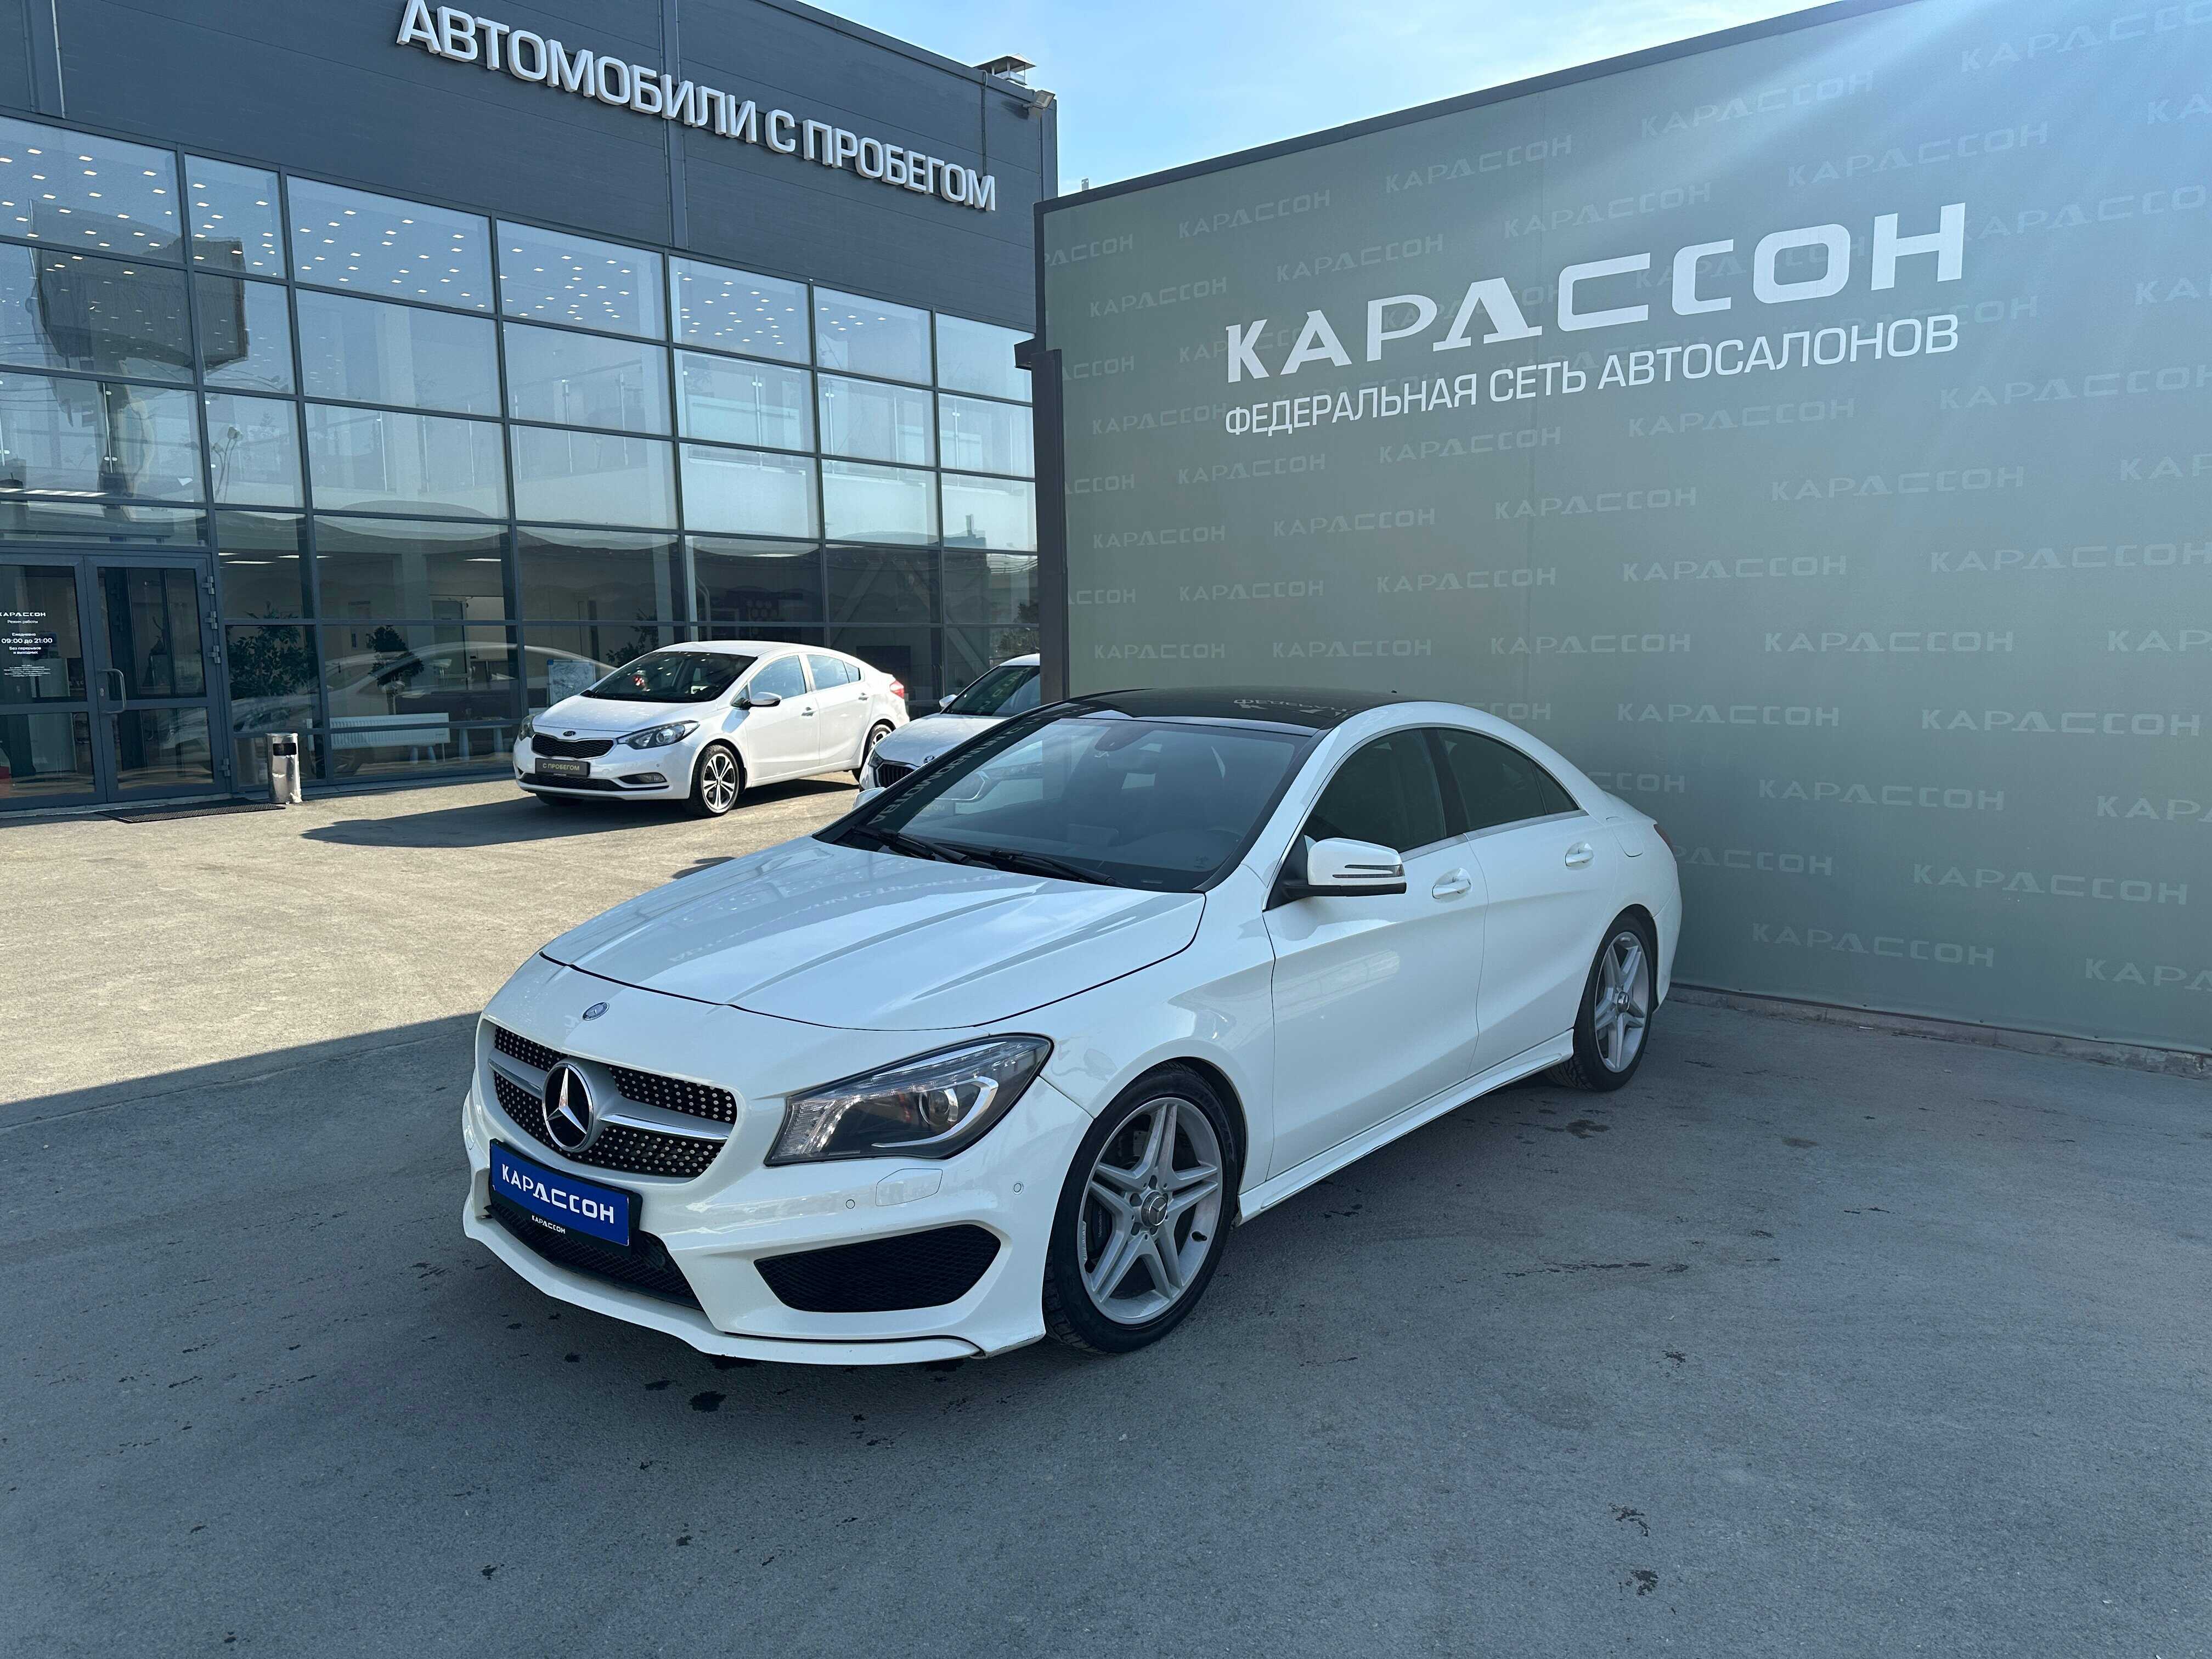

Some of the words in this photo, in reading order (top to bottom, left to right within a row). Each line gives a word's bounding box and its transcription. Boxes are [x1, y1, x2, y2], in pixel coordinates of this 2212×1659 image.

[396, 0, 757, 144] АВТОМОБИЛИ
[765, 109, 795, 154] С
[803, 119, 996, 211] ПРОБЕГОМ
[1640, 70, 1874, 139] КАРАССОН
[1385, 134, 1572, 194] КАРАССОН
[1787, 121, 2049, 187] КАРАССОН
[1178, 190, 1331, 239] КАРАССОН
[1503, 182, 1711, 239] КАРАССОН
[1276, 234, 1444, 282] КАРАССОН
[1090, 277, 1227, 317] КАРАССОН
[1225, 202, 1966, 383] КАРАССОН
[1225, 374, 1477, 436] ФЕДЕРАЛЬНАЯ
[1489, 361, 1587, 403] СЕТЬ
[1598, 314, 1959, 390] АВТОСАЛОНОВ
[1629, 398, 1855, 437] КАРАССОН
[1379, 426, 1561, 463] КАРАССОН
[1178, 453, 1326, 485] КАРАССОН
[1771, 466, 2024, 501] КАРАССОН
[1495, 487, 1697, 520] КАРАССОН
[1093, 524, 1226, 549] КАРАССОН
[1273, 508, 1436, 538] КАРАССОН
[1623, 556, 1847, 582] КАРАССОН
[1931, 542, 2212, 573] КАРАССОН
[1179, 580, 1324, 602] КАРАССОН
[1376, 567, 1556, 594] КАРАССОН
[1095, 643, 1226, 659] КАРАССОН
[1273, 639, 1432, 658] КАРАССОН
[1491, 633, 1691, 654] КАРАССОН
[1764, 631, 2013, 653] КАРАССОН
[1617, 703, 1839, 726] КАРАССОН
[1921, 709, 2200, 736] КАРАССОН
[1759, 779, 2005, 811] КАРАССОН
[1914, 864, 2188, 905] КАРАССОН
[1752, 923, 1995, 968] КАРАССОН
[502, 1163, 614, 1224] КАРАССОН
[532, 1214, 566, 1234] КАРАССОН
